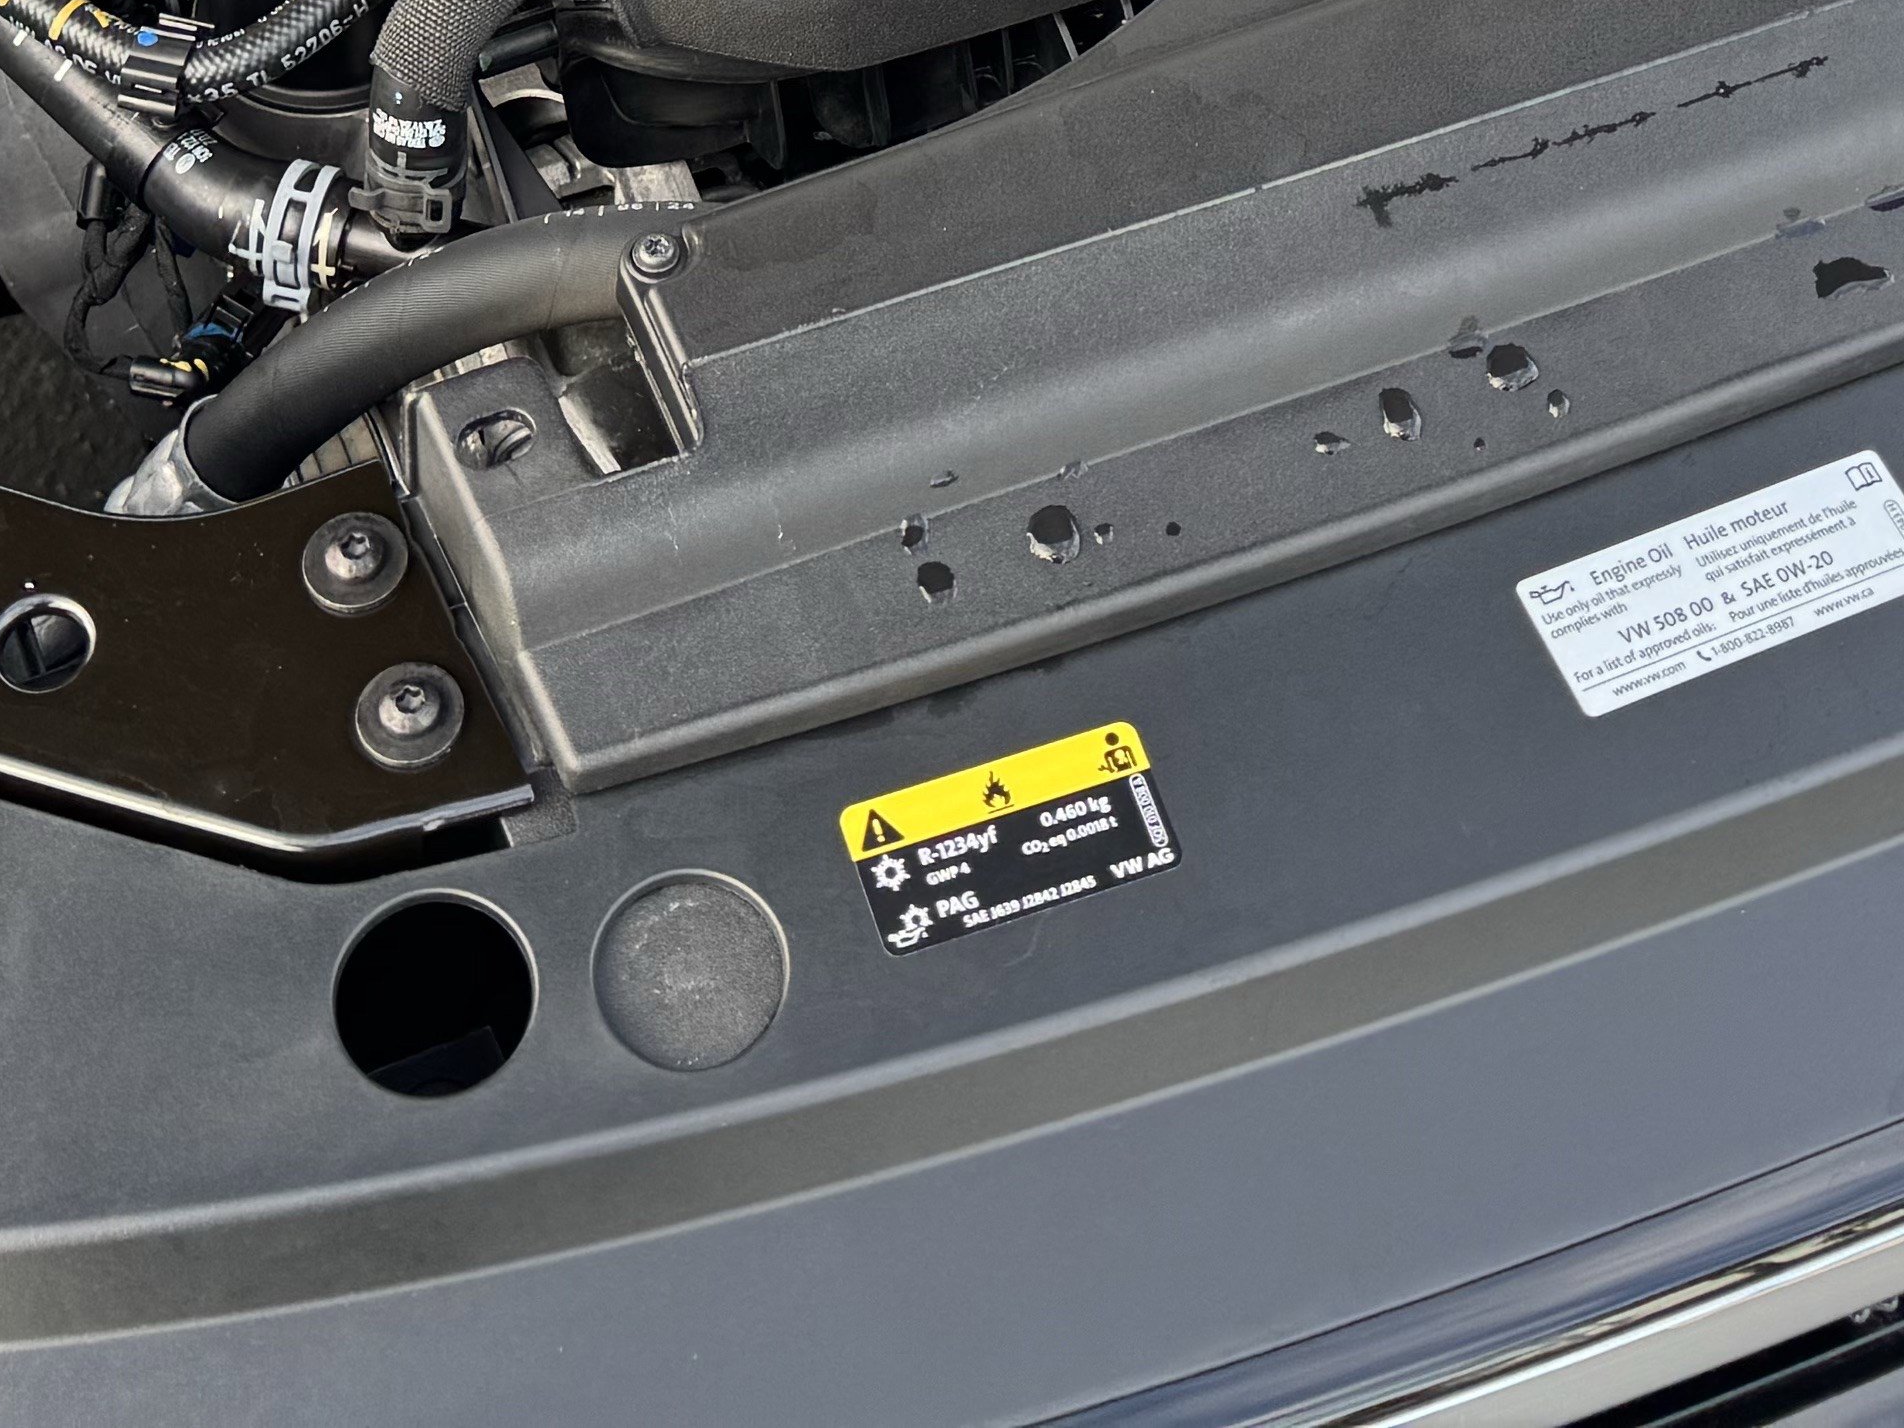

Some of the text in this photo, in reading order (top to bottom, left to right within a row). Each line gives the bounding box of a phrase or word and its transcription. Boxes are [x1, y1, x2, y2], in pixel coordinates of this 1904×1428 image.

[1542, 499, 1858, 625] Use only oil that expressly Utilisez uniquement de l'huile
[1551, 516, 1856, 639] complies with qui satisfait expressément à
[1589, 501, 1789, 586] Engine Oil Huile moteur
[1574, 670, 1594, 684] For
[1596, 665, 1604, 675] a
[1603, 657, 1624, 671] list
[1624, 649, 1636, 665] of
[1638, 629, 1692, 659] approved
[1691, 622, 1717, 637] oils:
[1728, 606, 1755, 623] Pour
[1757, 596, 1779, 612] une
[1778, 587, 1803, 602] liste
[1801, 572, 1845, 594] d'huiles
[1612, 661, 1687, 696] www.vw.com
[1813, 586, 1875, 617] www.vw.ca
[1617, 550, 1834, 644] VW 508 00 & SAE 0W-20
[917, 796, 1112, 865] R-1234yf 0.460 kg
[926, 865, 959, 885] GWP
[960, 862, 972, 874] 4
[1049, 834, 1067, 847] eq
[1065, 817, 1109, 841] 0.0018
[1109, 815, 1119, 827] t
[936, 890, 980, 918] PAG
[962, 909, 990, 928] SAE
[1022, 887, 1060, 909] J2842
[1060, 875, 1097, 897] J2845
[1109, 856, 1144, 879] VW
[1147, 847, 1175, 868] AG
